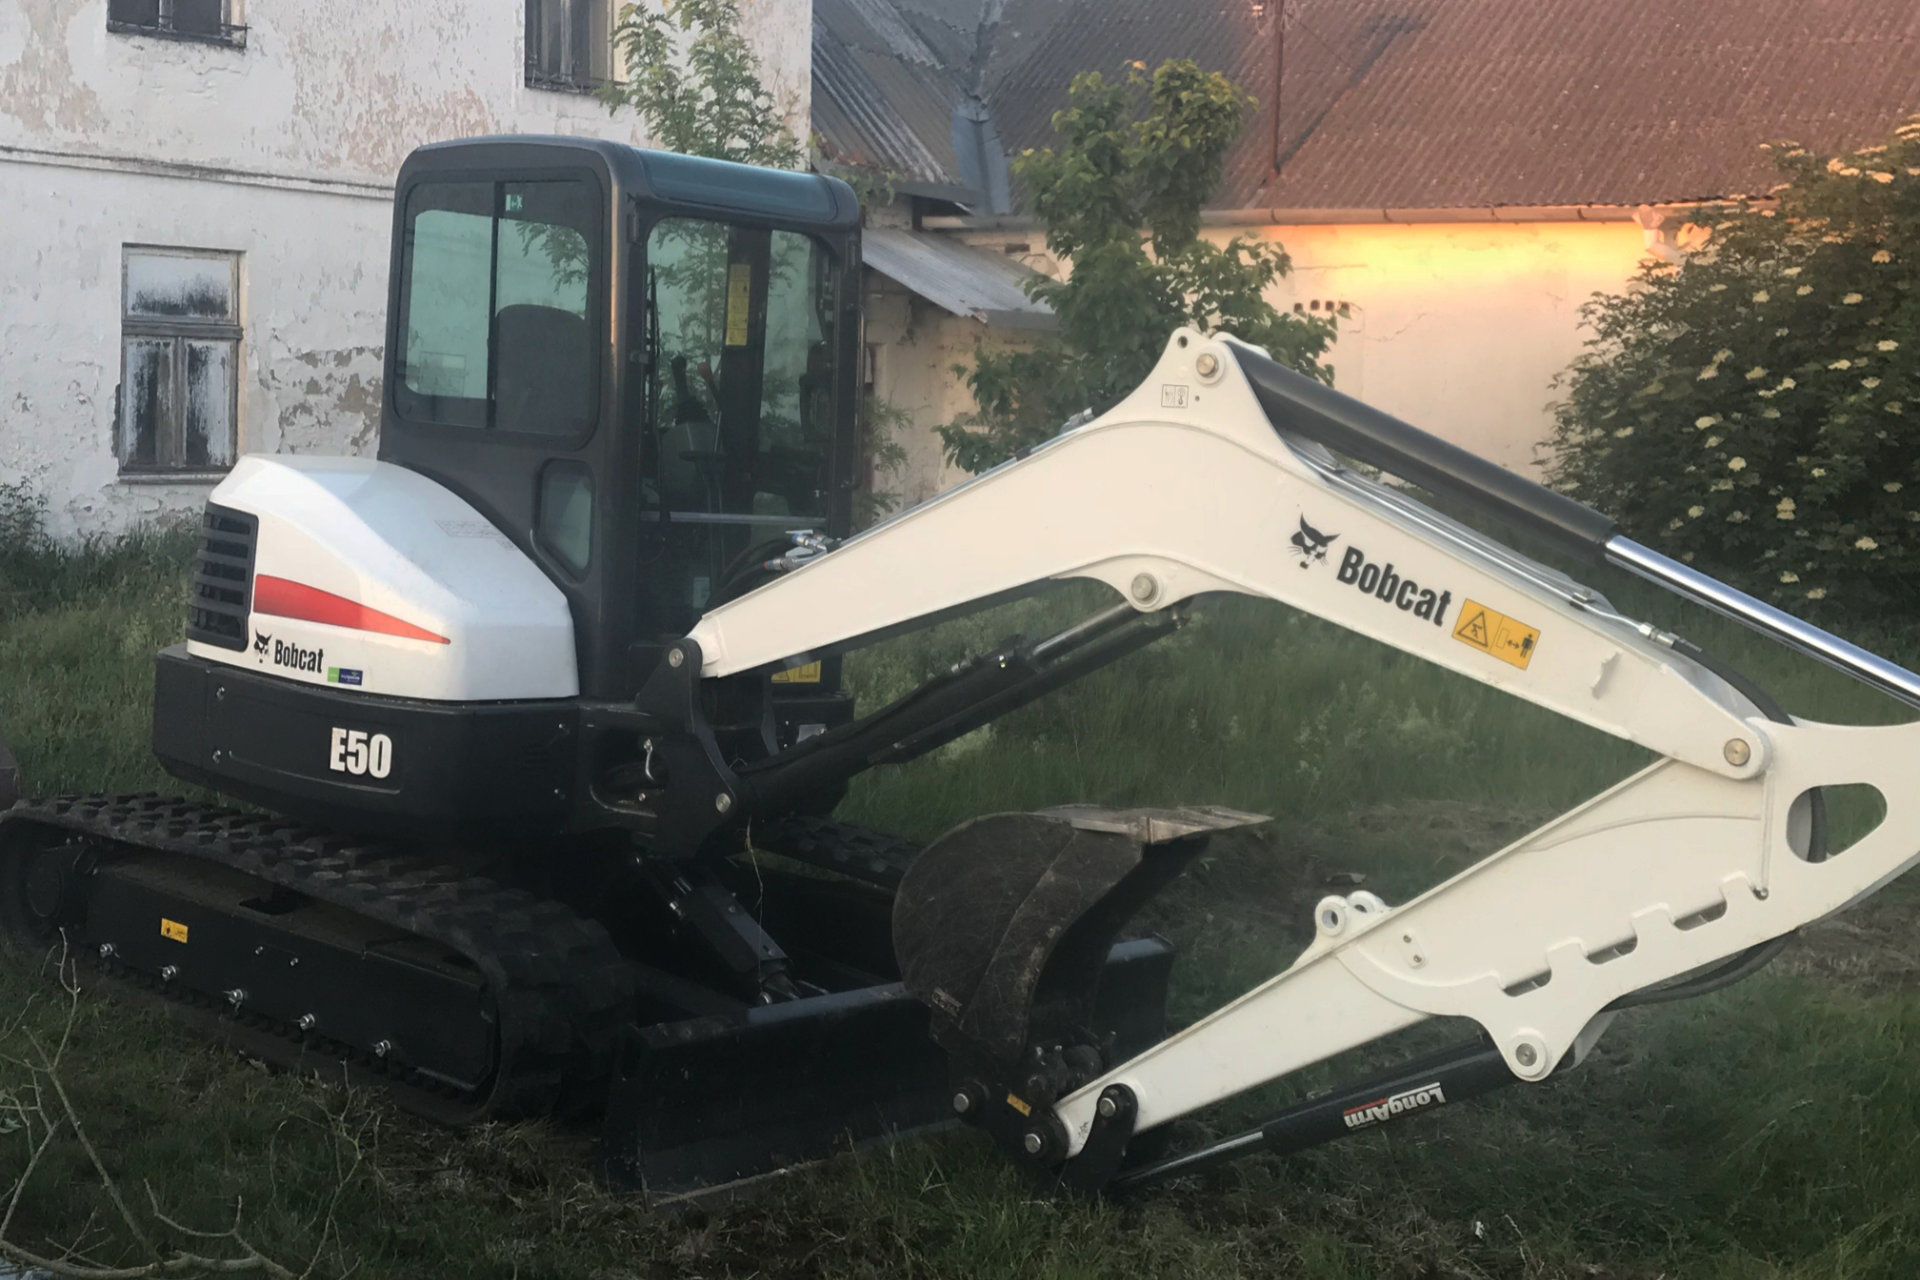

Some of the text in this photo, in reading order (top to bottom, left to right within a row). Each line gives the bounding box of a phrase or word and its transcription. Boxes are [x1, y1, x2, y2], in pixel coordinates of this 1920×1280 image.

[1337, 546, 1452, 627] Bobcat
[274, 639, 323, 673] Bobcat
[330, 727, 392, 779] E50
[1343, 1083, 1446, 1127] LongArm
